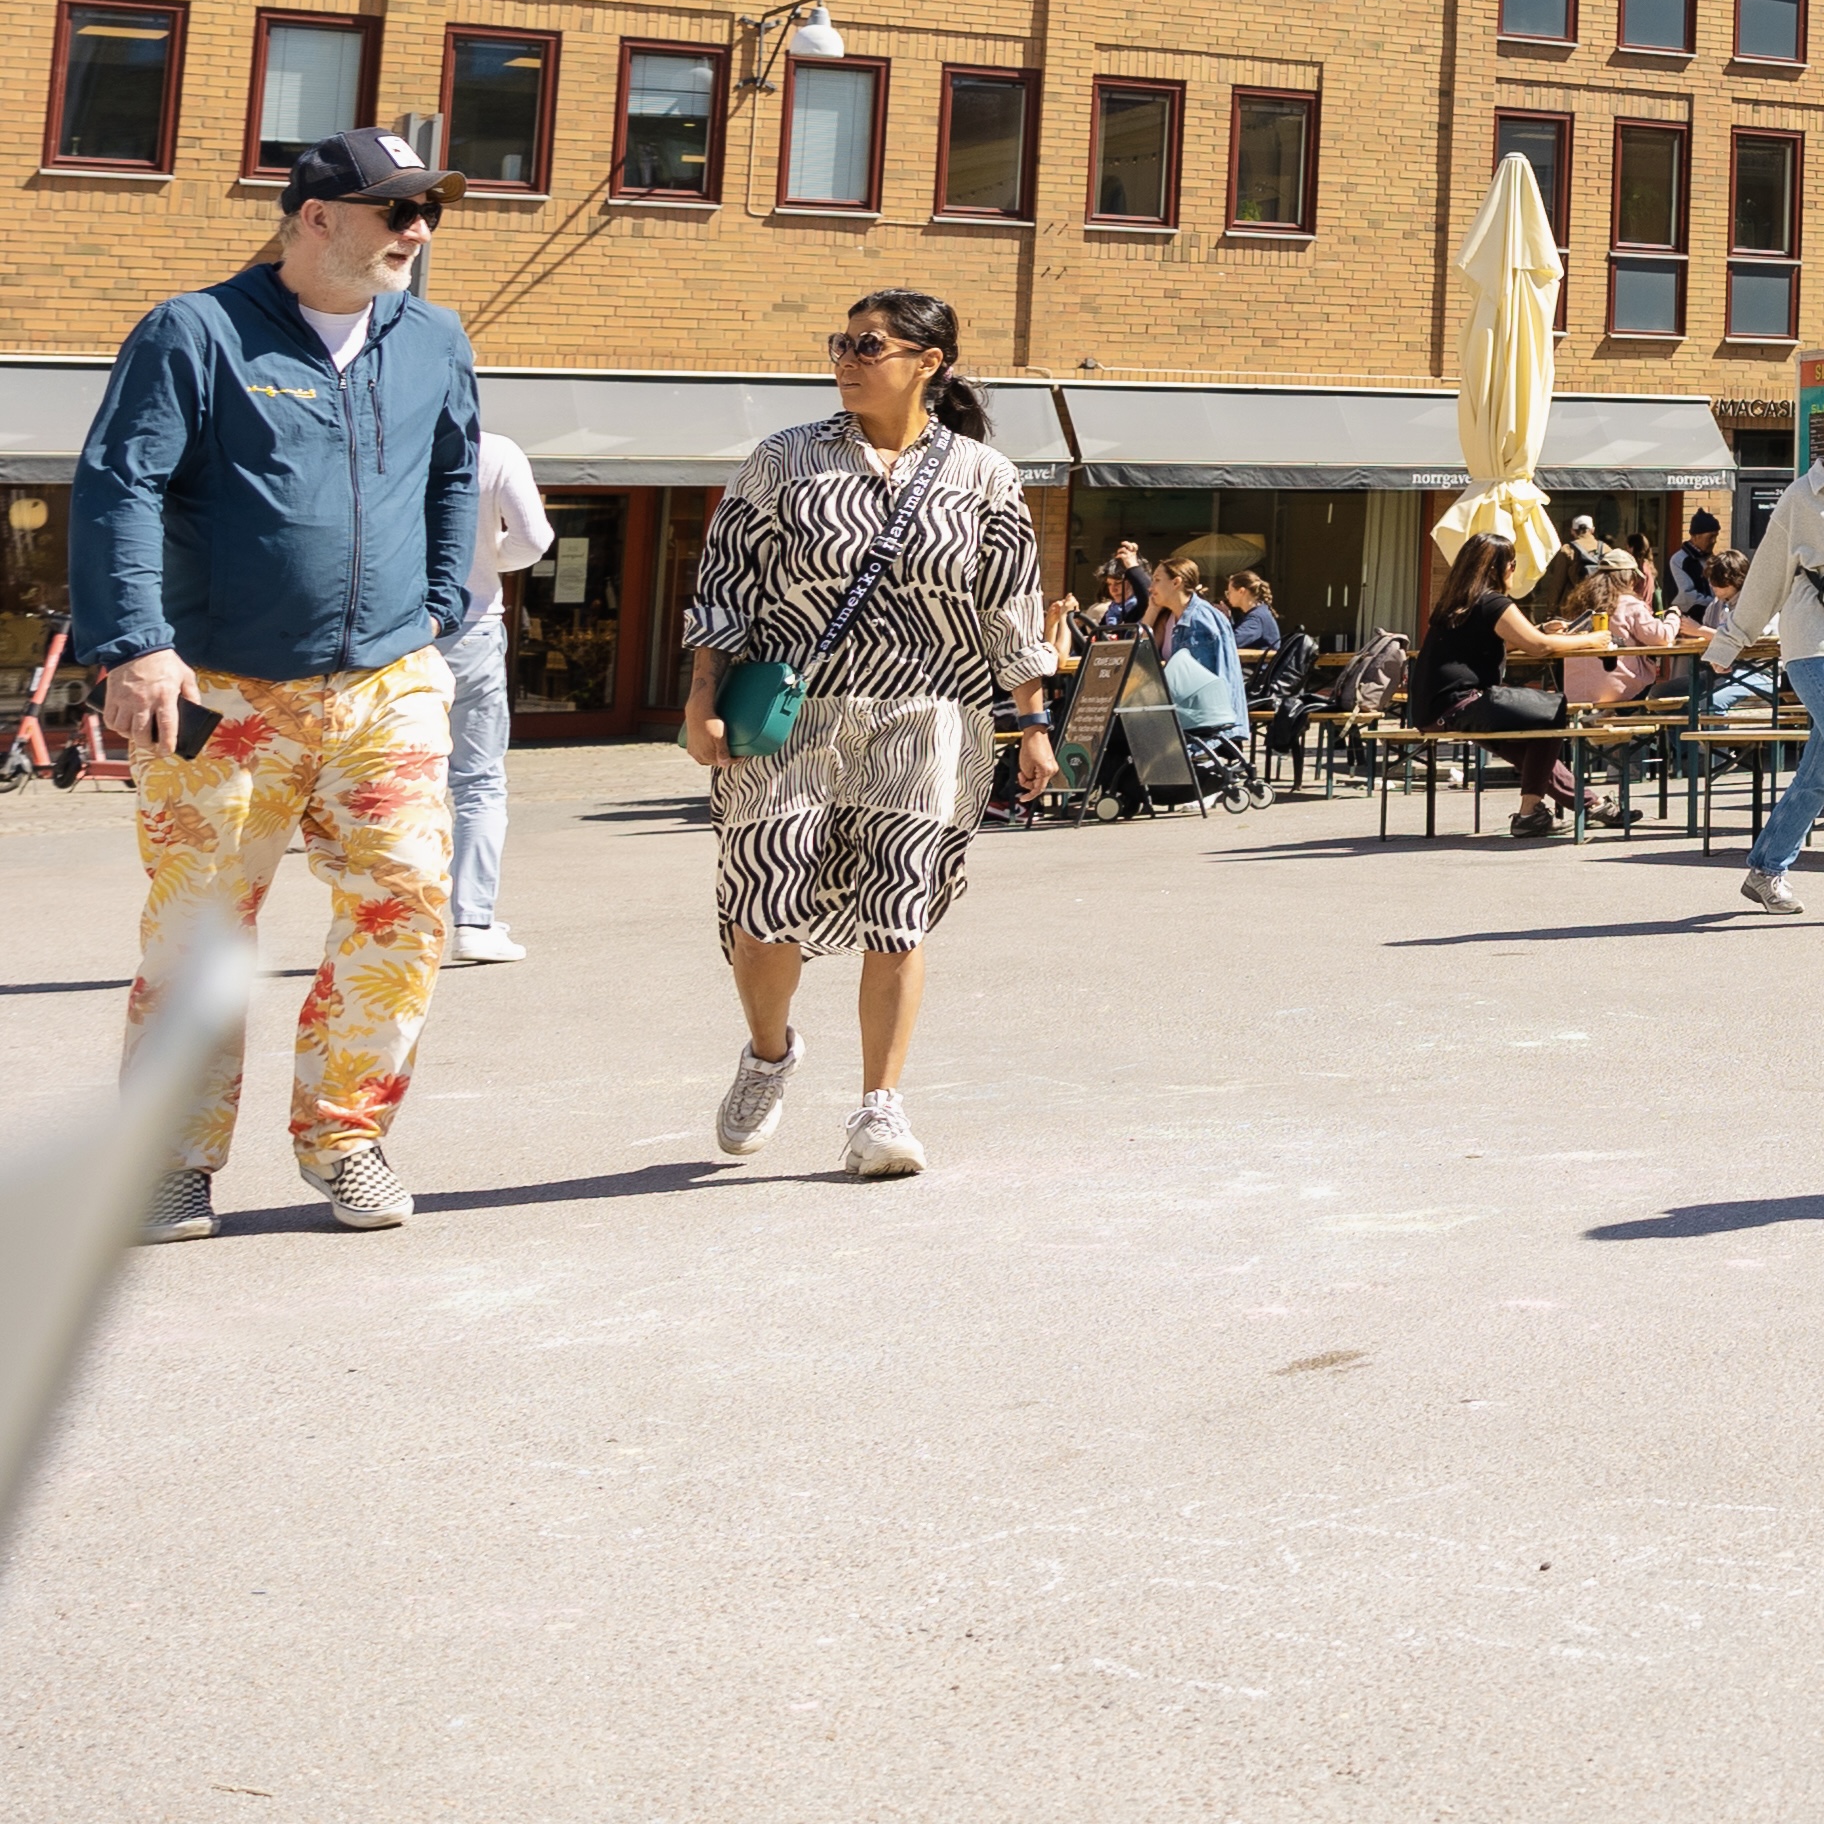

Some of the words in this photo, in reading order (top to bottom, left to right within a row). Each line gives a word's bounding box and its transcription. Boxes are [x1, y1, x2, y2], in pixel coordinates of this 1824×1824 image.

[1018, 463, 1056, 483] gavel
[1412, 473, 1473, 489] norrgave
[1667, 470, 1727, 490] norrgavel
[820, 561, 882, 651] arimekko
